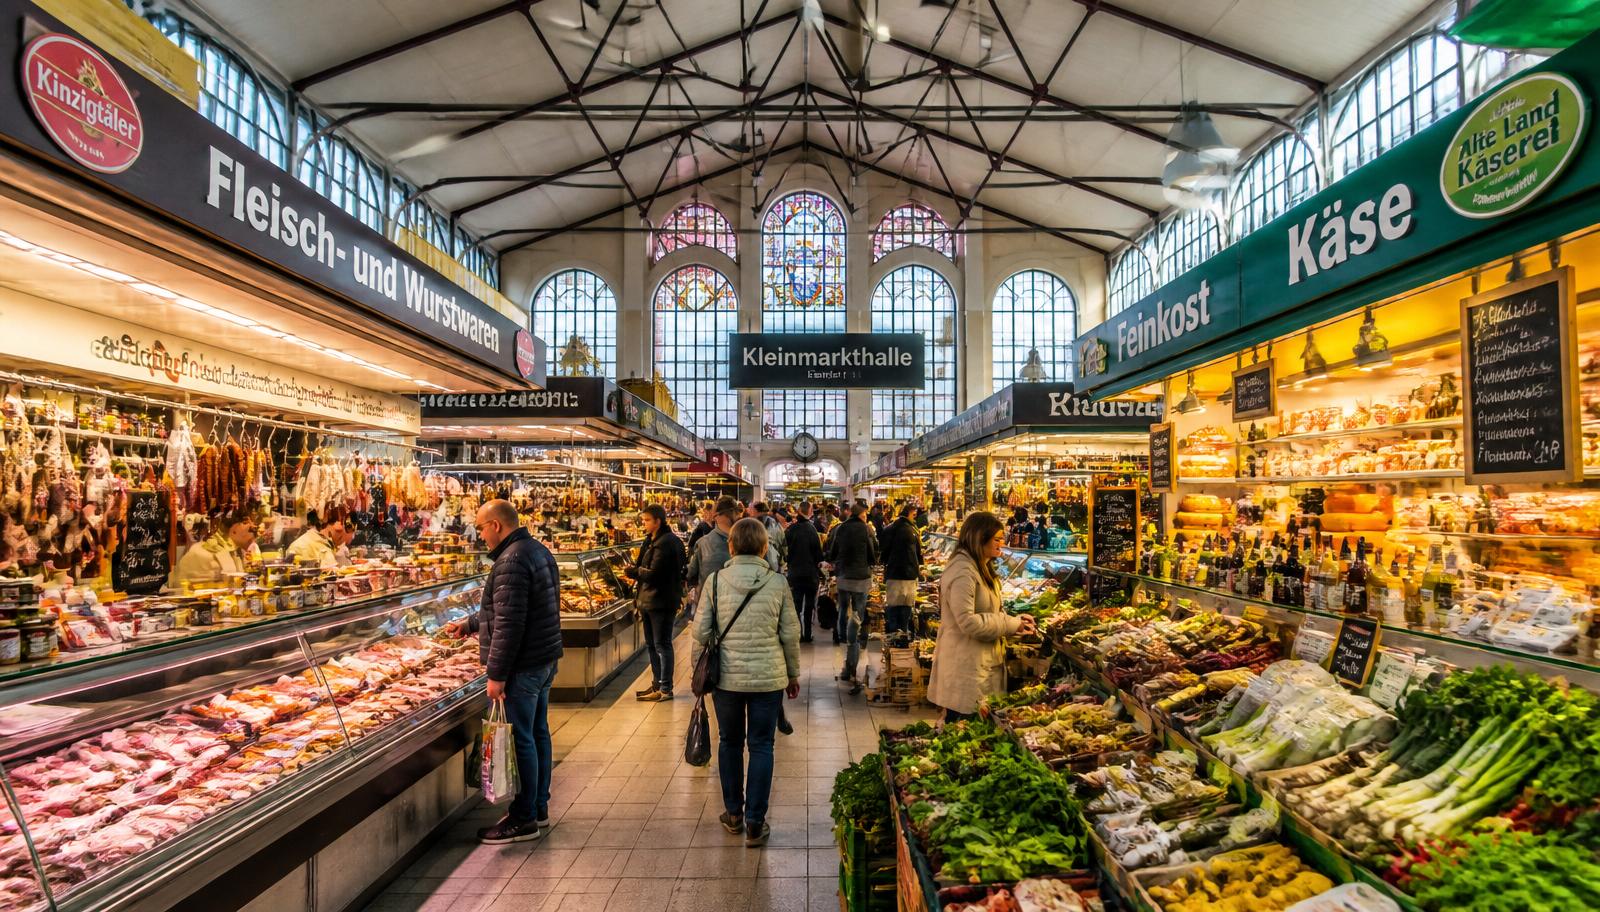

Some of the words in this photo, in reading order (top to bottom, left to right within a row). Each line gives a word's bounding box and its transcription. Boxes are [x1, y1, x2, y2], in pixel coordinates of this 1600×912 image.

[1458, 129, 1497, 163] Alte
[1503, 88, 1560, 139] Land
[206, 144, 346, 269] Fleisch-
[352, 244, 398, 302] und
[403, 265, 500, 354] Wurstwaren
[1287, 182, 1413, 286] Käse
[742, 346, 913, 367] Kleinmarkthalle
[1115, 278, 1212, 362] Feinkost
